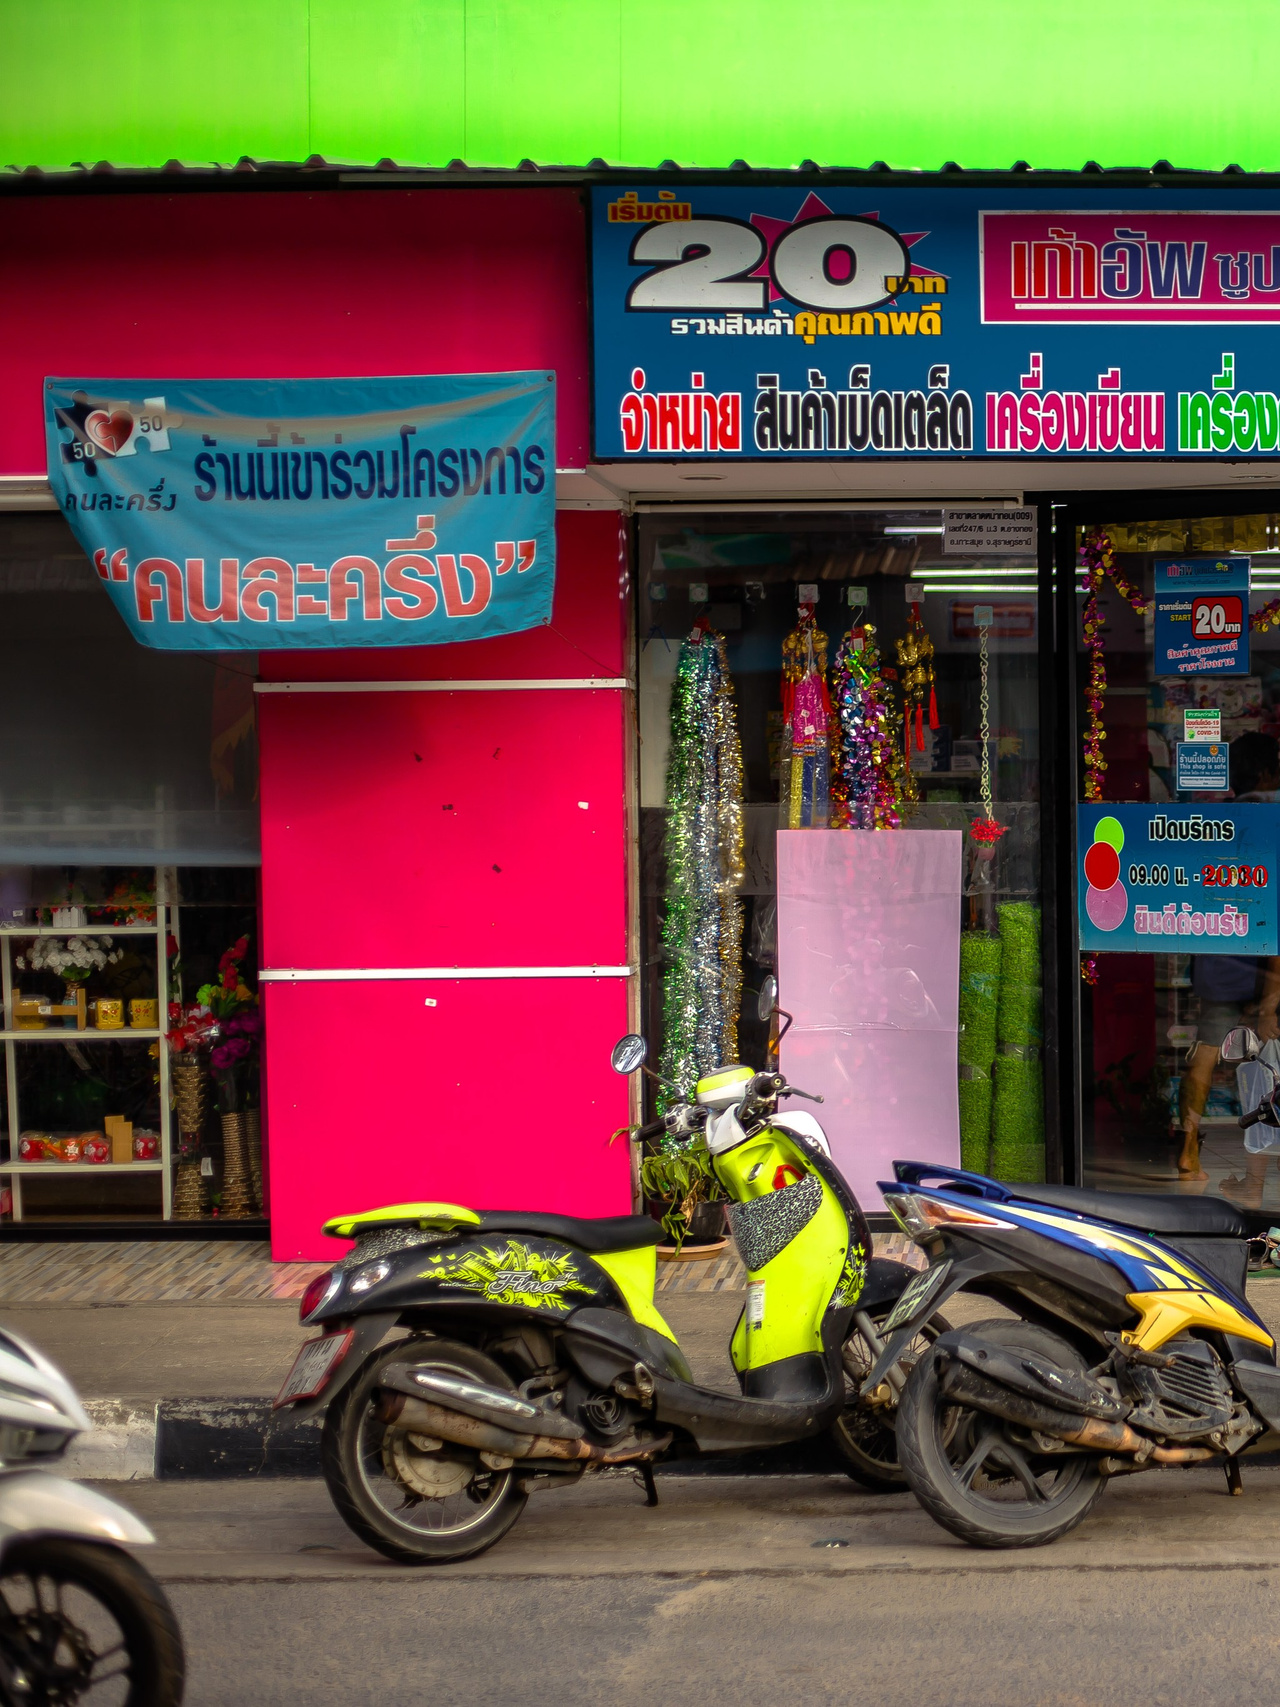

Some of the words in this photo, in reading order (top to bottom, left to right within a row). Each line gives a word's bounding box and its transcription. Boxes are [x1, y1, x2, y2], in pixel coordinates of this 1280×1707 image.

[608, 191, 692, 222] เริ่มต้น
[625, 214, 911, 312] 20
[1011, 227, 1208, 299] เก้าอัพ
[884, 275, 948, 294] บาท
[620, 366, 742, 453] จำหน่าย
[754, 363, 974, 453] สินค้าเบ็ดเตล็ด
[986, 352, 1166, 453] เครื่องเขียน
[139, 415, 163, 433] 50
[72, 442, 96, 459] 50
[65, 478, 177, 512] คนละครึ่ง
[1195, 604, 1226, 634] 20
[1225, 623, 1241, 633] บาท
[1149, 814, 1235, 841] เปิดบริการ
[1128, 864, 1170, 886] 09.00
[1134, 902, 1249, 937] ยินดีต้อนรับ
[487, 1270, 567, 1293] Fino
